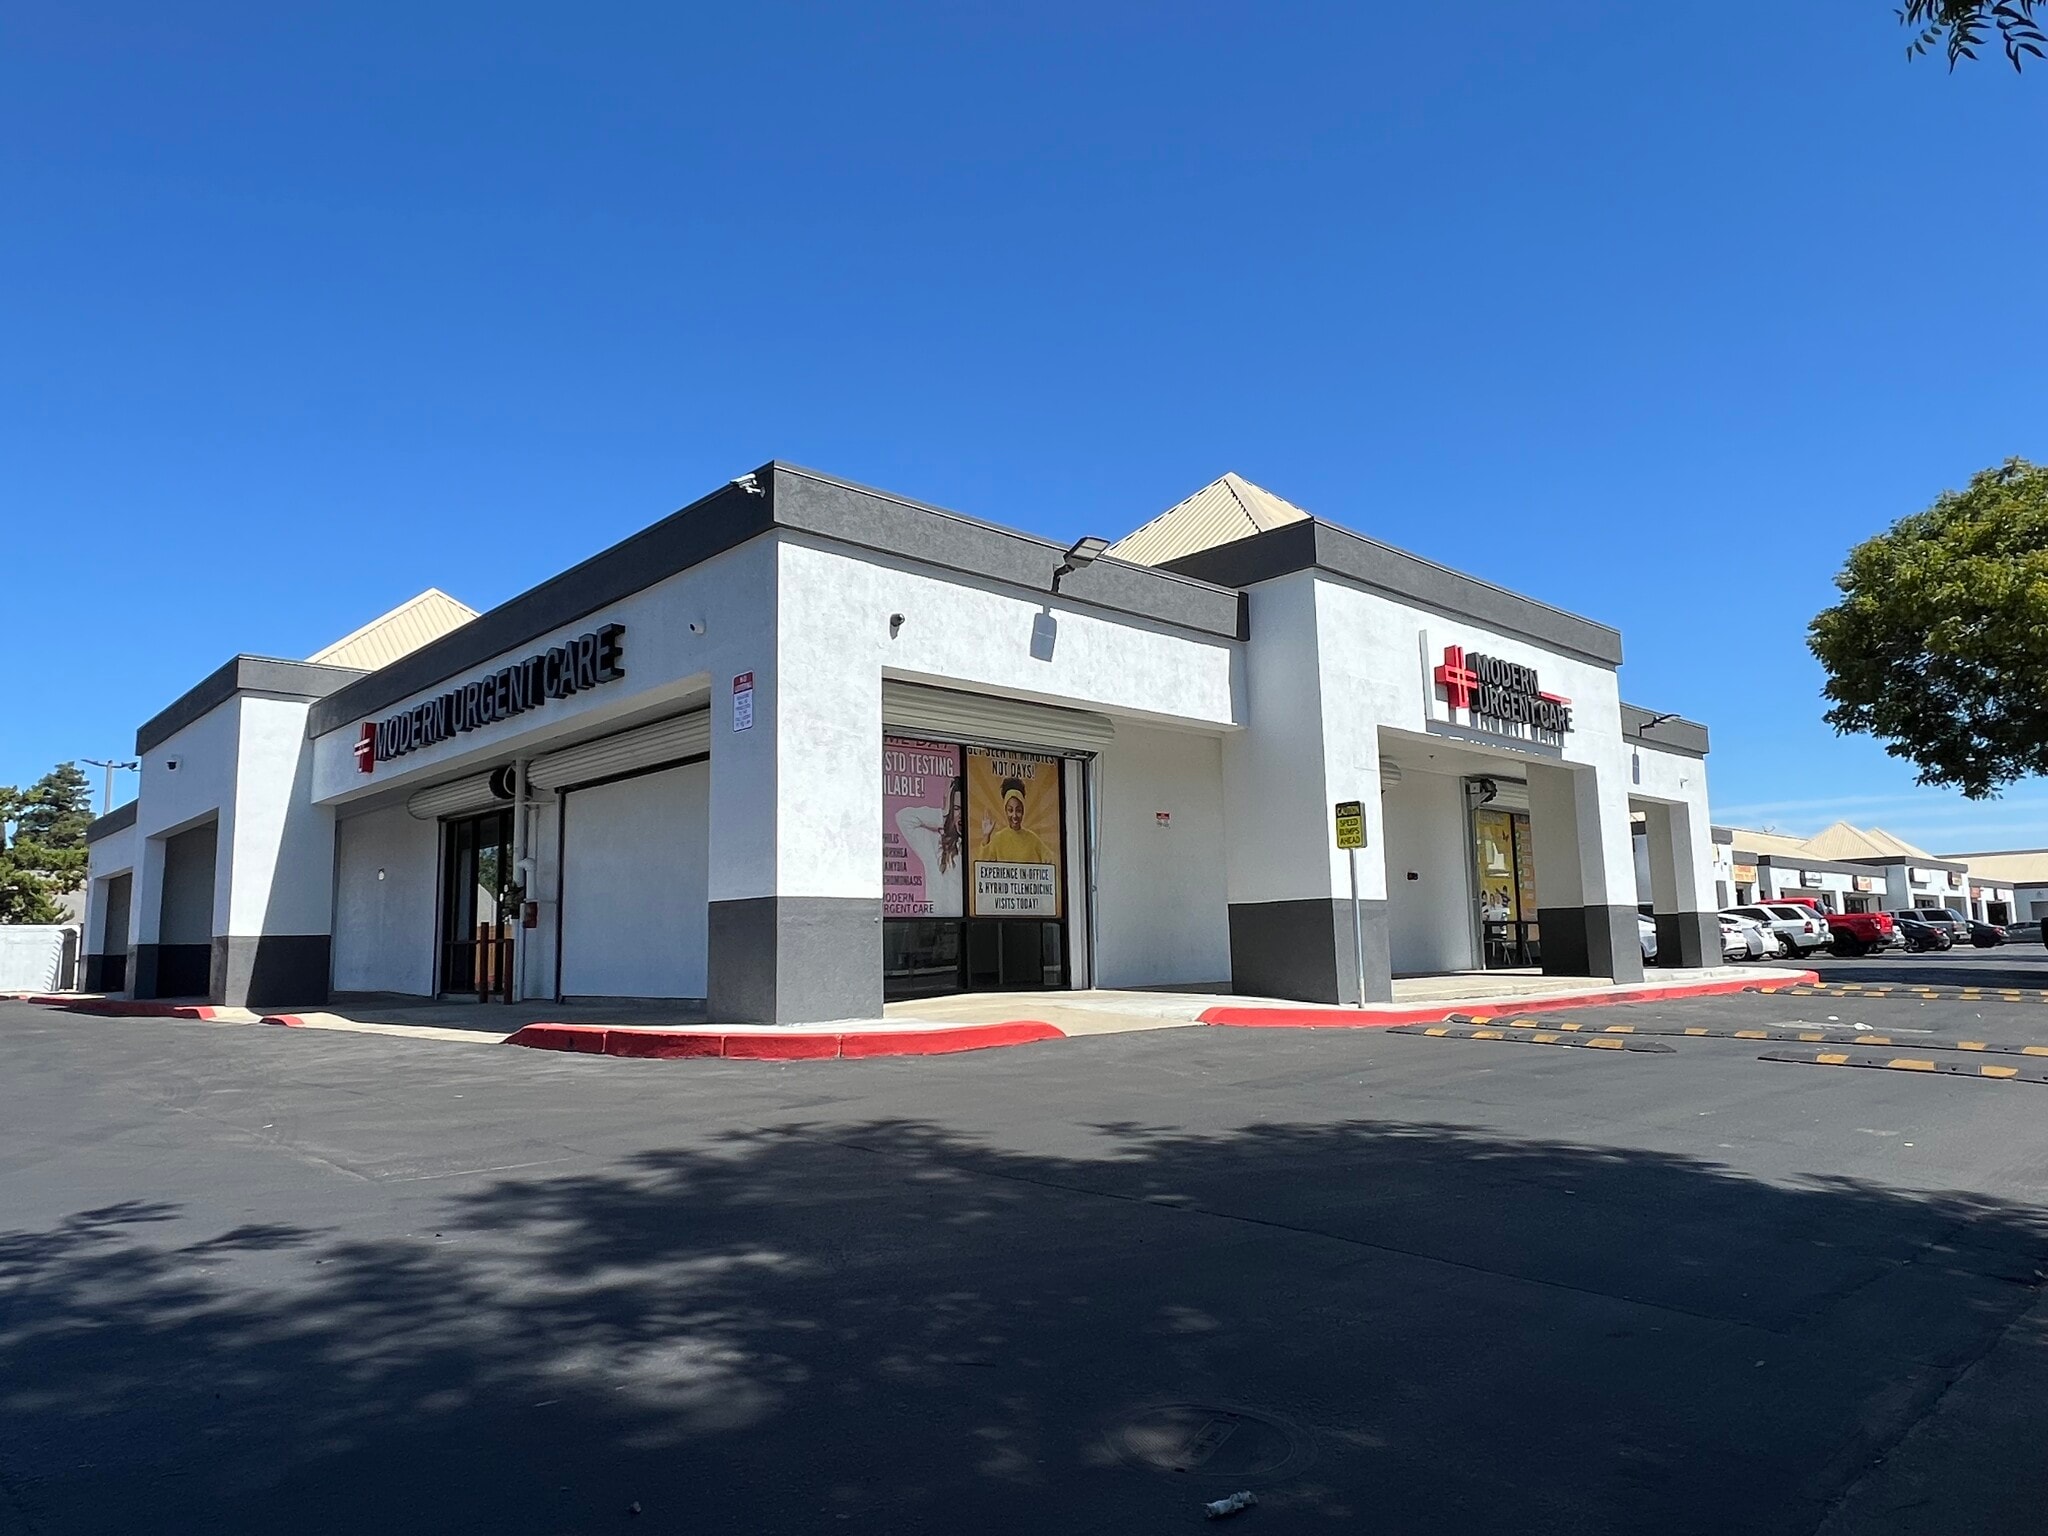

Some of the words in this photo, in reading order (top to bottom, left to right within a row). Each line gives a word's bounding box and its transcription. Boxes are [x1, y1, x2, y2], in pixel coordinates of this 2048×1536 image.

[1467, 652, 1539, 696] MODERN
[375, 694, 456, 761] MODERN
[452, 656, 545, 732] URGENT
[543, 623, 626, 699] CARE
[1472, 683, 1536, 727] URGENT
[1537, 700, 1575, 733] CARE
[885, 751, 906, 772] STD
[909, 753, 954, 777] TESTING
[992, 760, 1008, 776] NOT
[1010, 763, 1036, 779] DAYS!
[883, 774, 925, 797] ILABLE!
[1339, 818, 1359, 827] SPEED
[1340, 836, 1360, 845] AHEAD
[980, 867, 1018, 879] EXPERIENCE
[978, 882, 984, 894] &
[985, 882, 1009, 895] HYBRID
[1010, 883, 1053, 896] TELEMEDICINE
[884, 892, 915, 903] ODERN
[994, 897, 1016, 910] VISITS
[1016, 898, 1039, 910] TODAY!
[883, 904, 911, 914] RGENT
[912, 904, 935, 914] CARE
